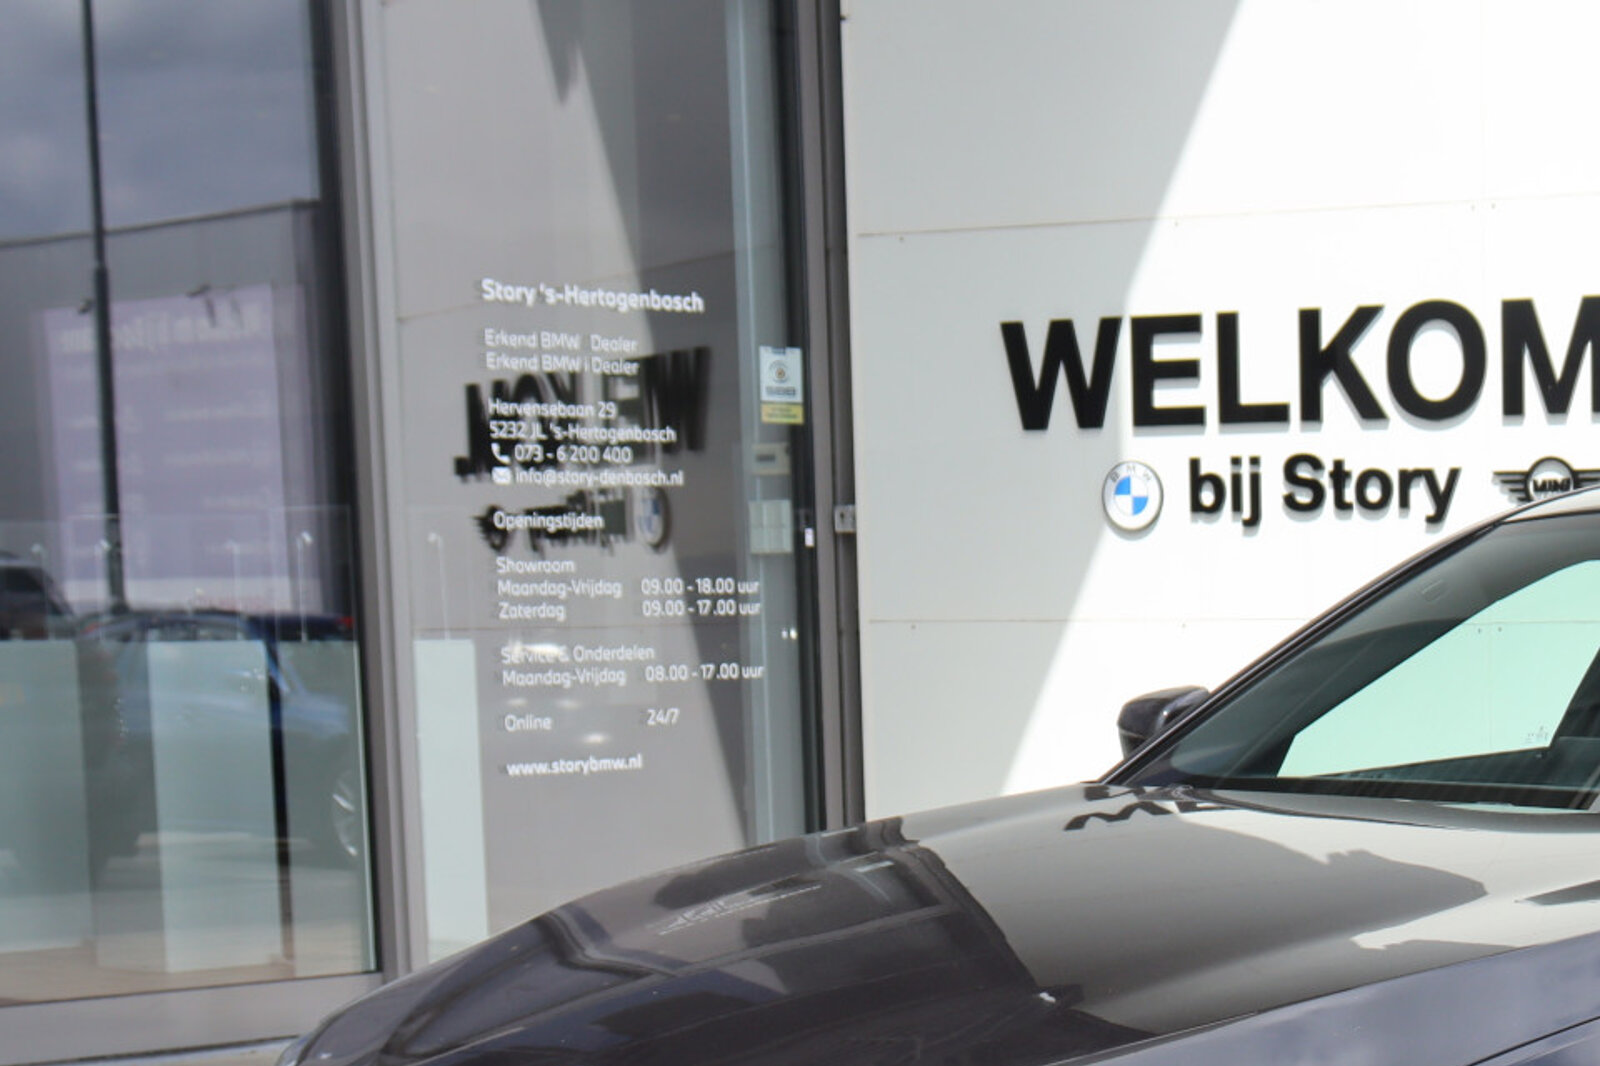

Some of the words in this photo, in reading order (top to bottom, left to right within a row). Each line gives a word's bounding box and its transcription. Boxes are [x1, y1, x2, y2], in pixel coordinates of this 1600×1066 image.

[481, 277, 536, 308] Story
[539, 282, 705, 314] 's-Hertogenbosch
[484, 327, 538, 350] Erkend
[540, 330, 580, 351] BMW
[590, 333, 639, 354] Dealer
[486, 351, 539, 372] Erkend
[541, 353, 581, 374] BMW
[591, 356, 640, 376] Dealer
[489, 398, 596, 419] Hervensebaan
[598, 401, 618, 419] 29
[490, 420, 527, 440] 5232
[528, 421, 549, 441] JL
[550, 422, 678, 445] 's-Hertogenbosch
[514, 444, 545, 463] 073
[556, 445, 567, 463] 6
[569, 445, 599, 464] 200
[602, 446, 634, 465] 400
[515, 467, 685, 489] info@story-denbosch.nl
[1189, 456, 1262, 528] bij
[1282, 454, 1460, 528] Story
[493, 510, 606, 533] Openingstijden
[495, 557, 576, 574] Showroom
[497, 579, 622, 598] Maandag-Vrijdag
[640, 577, 684, 596] 09.00
[695, 578, 736, 595] 18.00
[738, 581, 760, 594] uur
[499, 602, 566, 621] Zaterdag
[642, 600, 686, 617] 09.00
[697, 599, 736, 616] 17.00
[739, 602, 761, 615] uur
[573, 645, 656, 663] Onderdelen
[502, 667, 627, 688] Maandag-Vrijdag
[645, 665, 689, 683] 08.00
[700, 663, 739, 682] 17.00
[741, 666, 764, 680] uur
[504, 714, 553, 732] Online
[646, 708, 680, 726] 24/7
[506, 753, 643, 777] www.storybmw.nl
